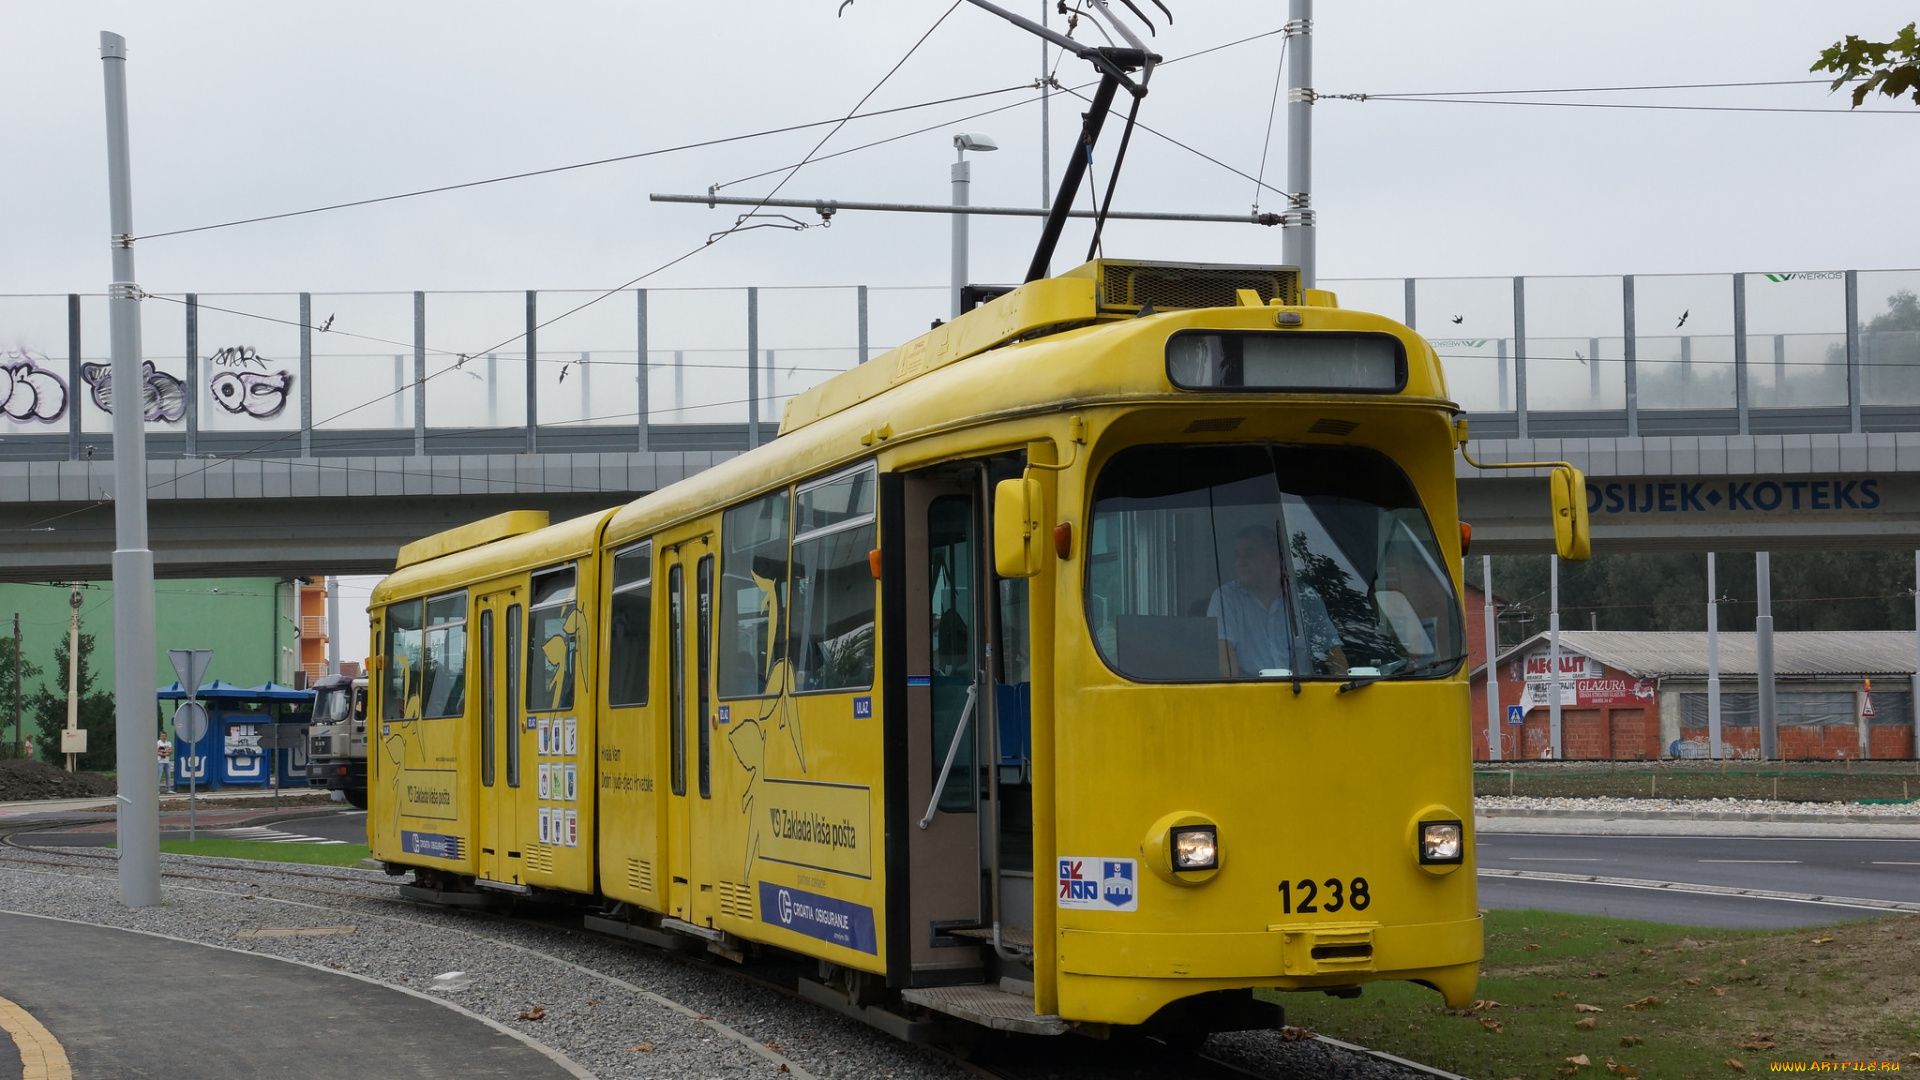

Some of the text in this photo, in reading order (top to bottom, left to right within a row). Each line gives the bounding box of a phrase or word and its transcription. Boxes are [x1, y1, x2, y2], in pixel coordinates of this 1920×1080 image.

[1797, 272, 1843, 280] WERKOS
[1586, 480, 1880, 514] OSIJEK KOTEKS
[1578, 680, 1626, 691] GLAZURA
[856, 701, 869, 714] ULAZ
[782, 809, 856, 851] Zaklada Vaša pošta
[1278, 877, 1370, 914] 1238
[793, 902, 849, 930] CROATIA OSIGURANJE
